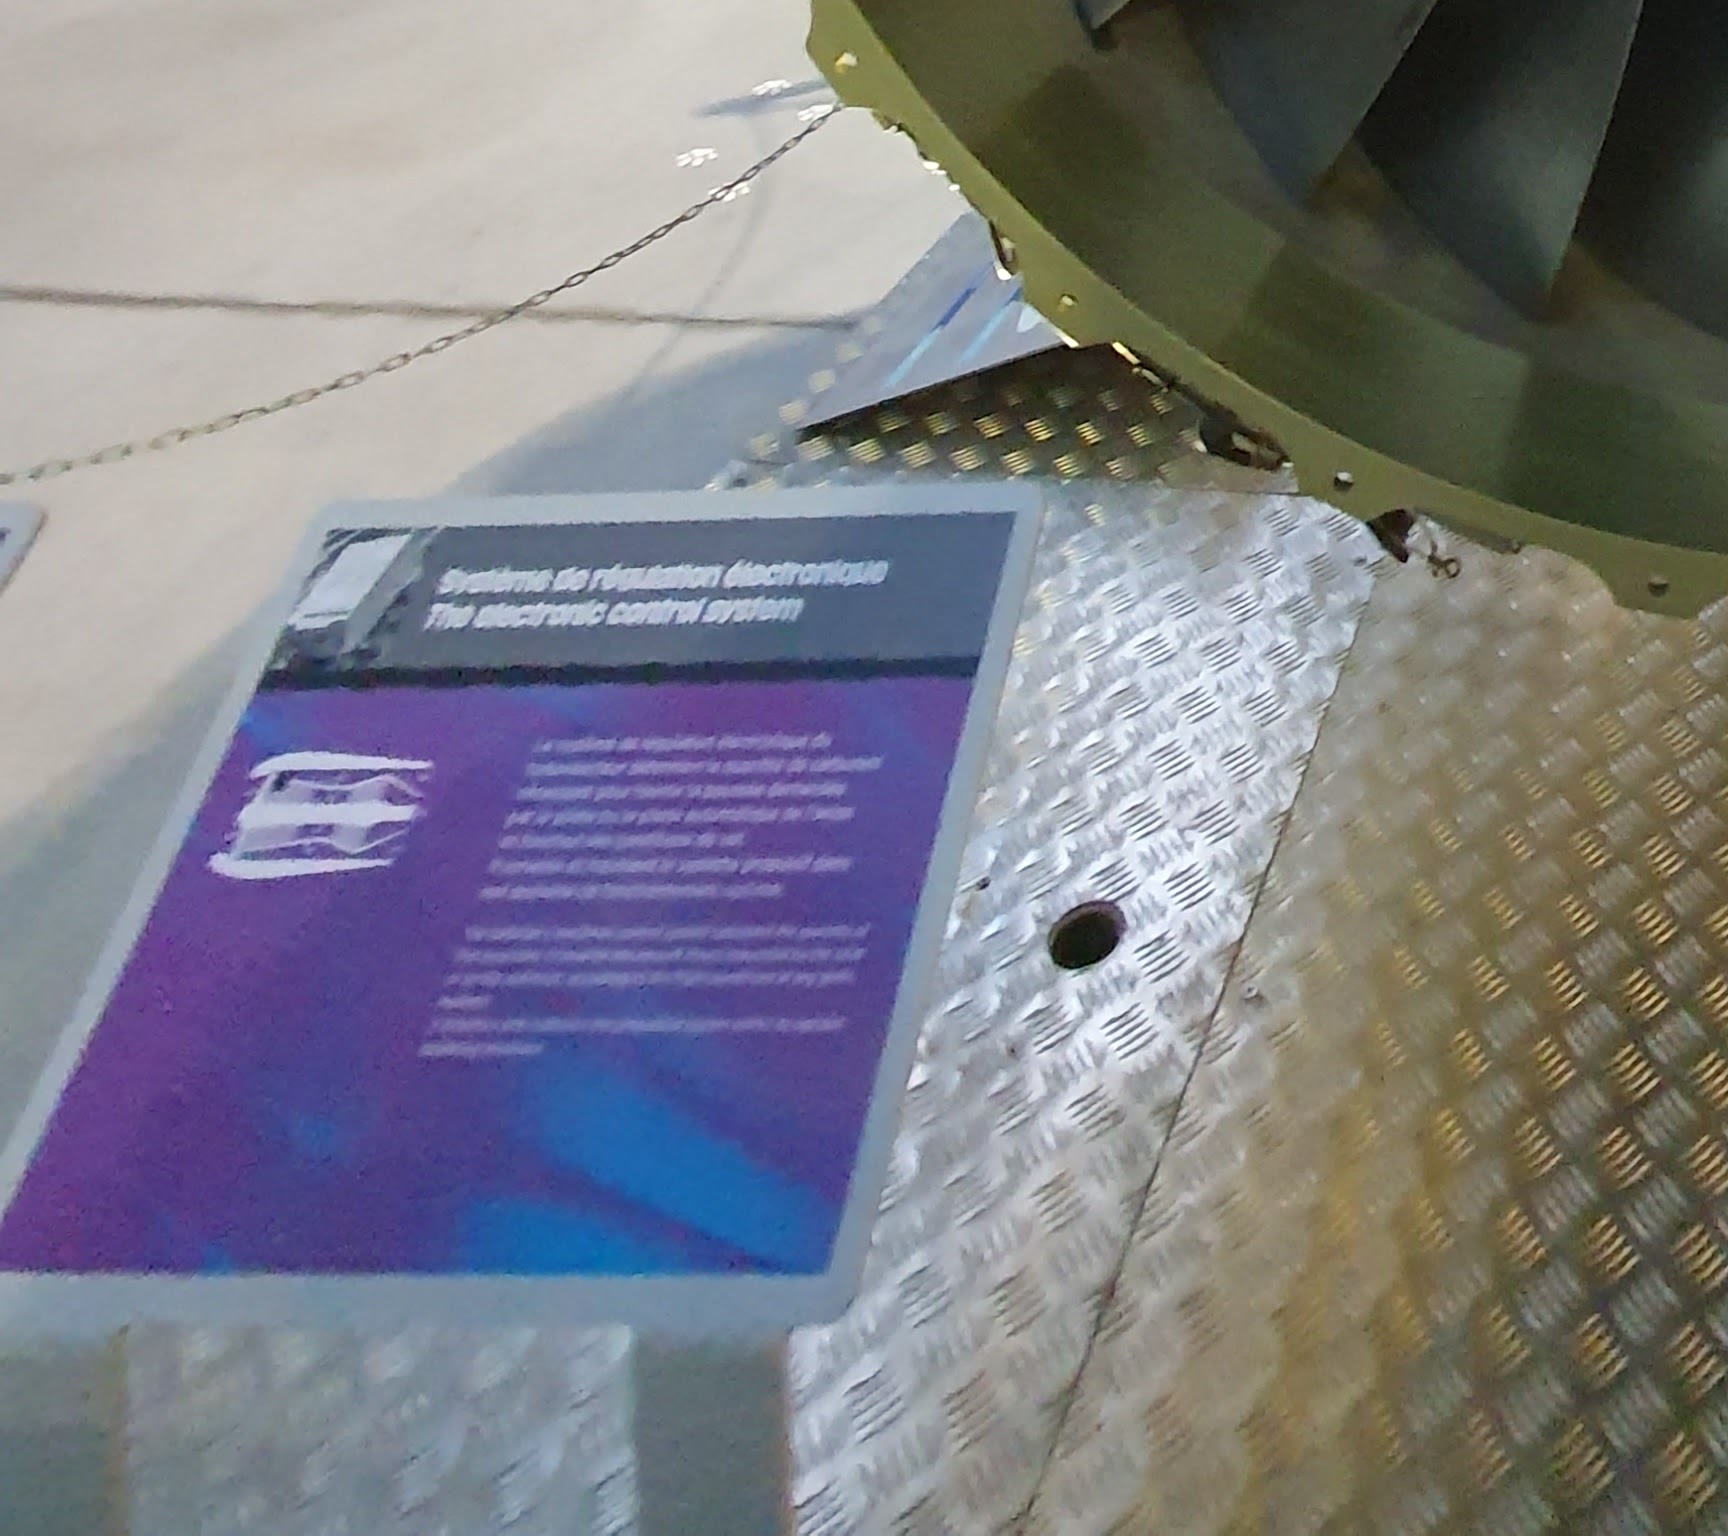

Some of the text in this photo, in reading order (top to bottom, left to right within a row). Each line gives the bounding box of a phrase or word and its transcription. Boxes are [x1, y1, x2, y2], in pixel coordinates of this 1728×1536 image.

[435, 558, 889, 595] Système de régulation électronique
[424, 595, 805, 631] The electronic control system
